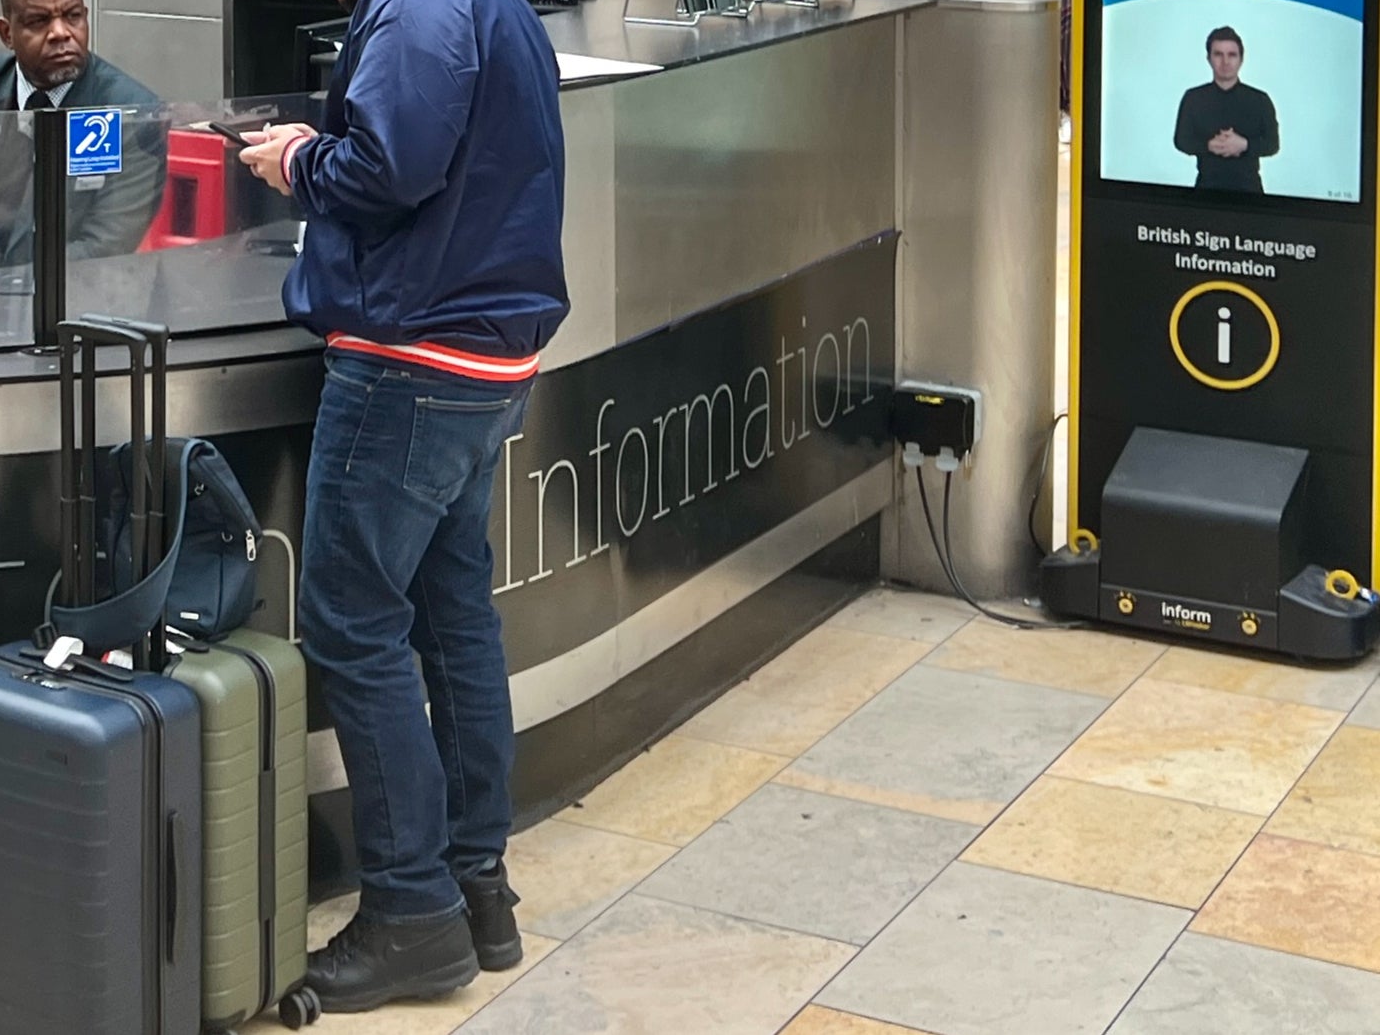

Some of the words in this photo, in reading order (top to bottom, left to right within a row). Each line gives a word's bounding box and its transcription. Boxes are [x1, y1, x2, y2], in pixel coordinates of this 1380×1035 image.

[1137, 226, 1191, 246] British
[1195, 230, 1231, 251] Sign
[1234, 234, 1316, 259] Language
[1175, 253, 1276, 277] Information
[492, 316, 874, 594] Information
[1162, 602, 1211, 623] inform
